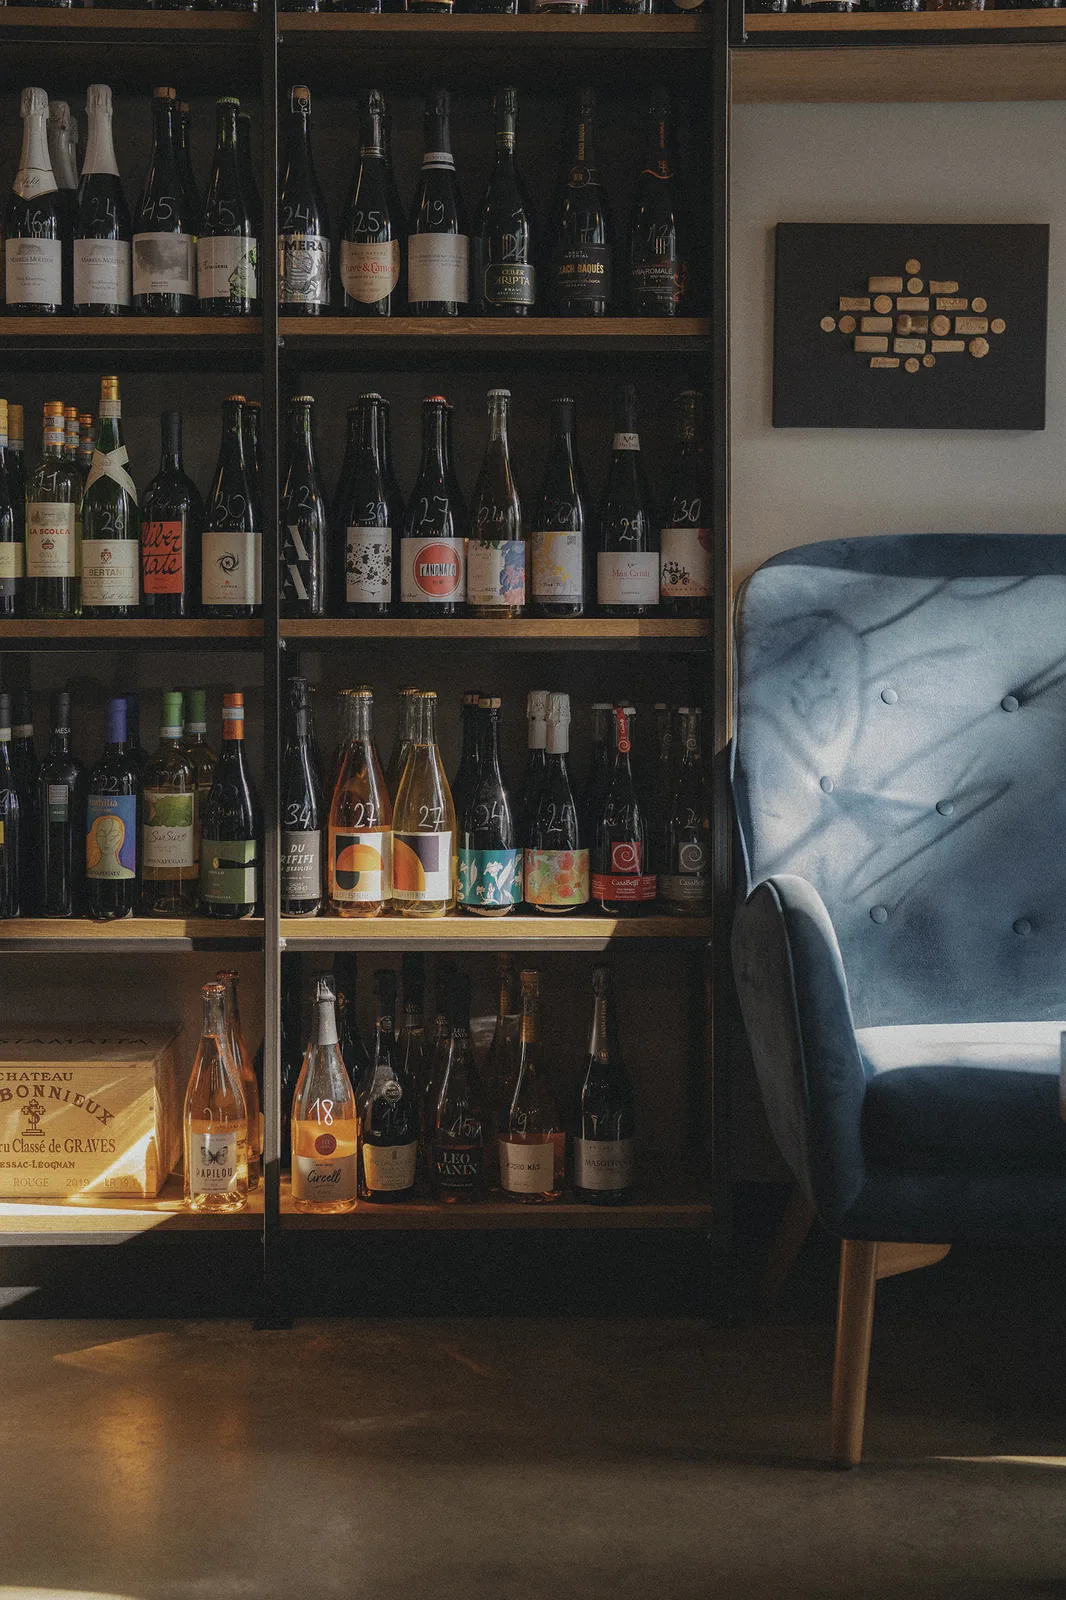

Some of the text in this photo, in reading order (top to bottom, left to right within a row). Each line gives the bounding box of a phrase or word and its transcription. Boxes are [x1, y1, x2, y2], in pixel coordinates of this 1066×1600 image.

[24, 208, 44, 234] 16
[141, 196, 176, 222] 45
[282, 203, 310, 230] 24
[423, 200, 446, 226] 19
[355, 210, 381, 234] 25
[363, 263, 371, 273] &
[215, 490, 246, 528] 30
[420, 495, 449, 525] 27
[673, 498, 701, 522] 30
[101, 511, 125, 536] 26
[55, 727, 73, 735] MESA
[284, 803, 313, 829] 34
[353, 802, 377, 829] 27
[418, 805, 446, 832] 27
[281, 854, 315, 864] RIFIFI
[290, 844, 306, 853] DU
[309, 1098, 333, 1126] 18
[12, 1138, 46, 1153] Classé
[48, 1139, 61, 1153] de
[64, 1138, 115, 1153] GRAVES
[442, 1152, 471, 1165] LEO
[13, 1177, 49, 1187] ROUGE
[66, 1179, 90, 1187] 2019
